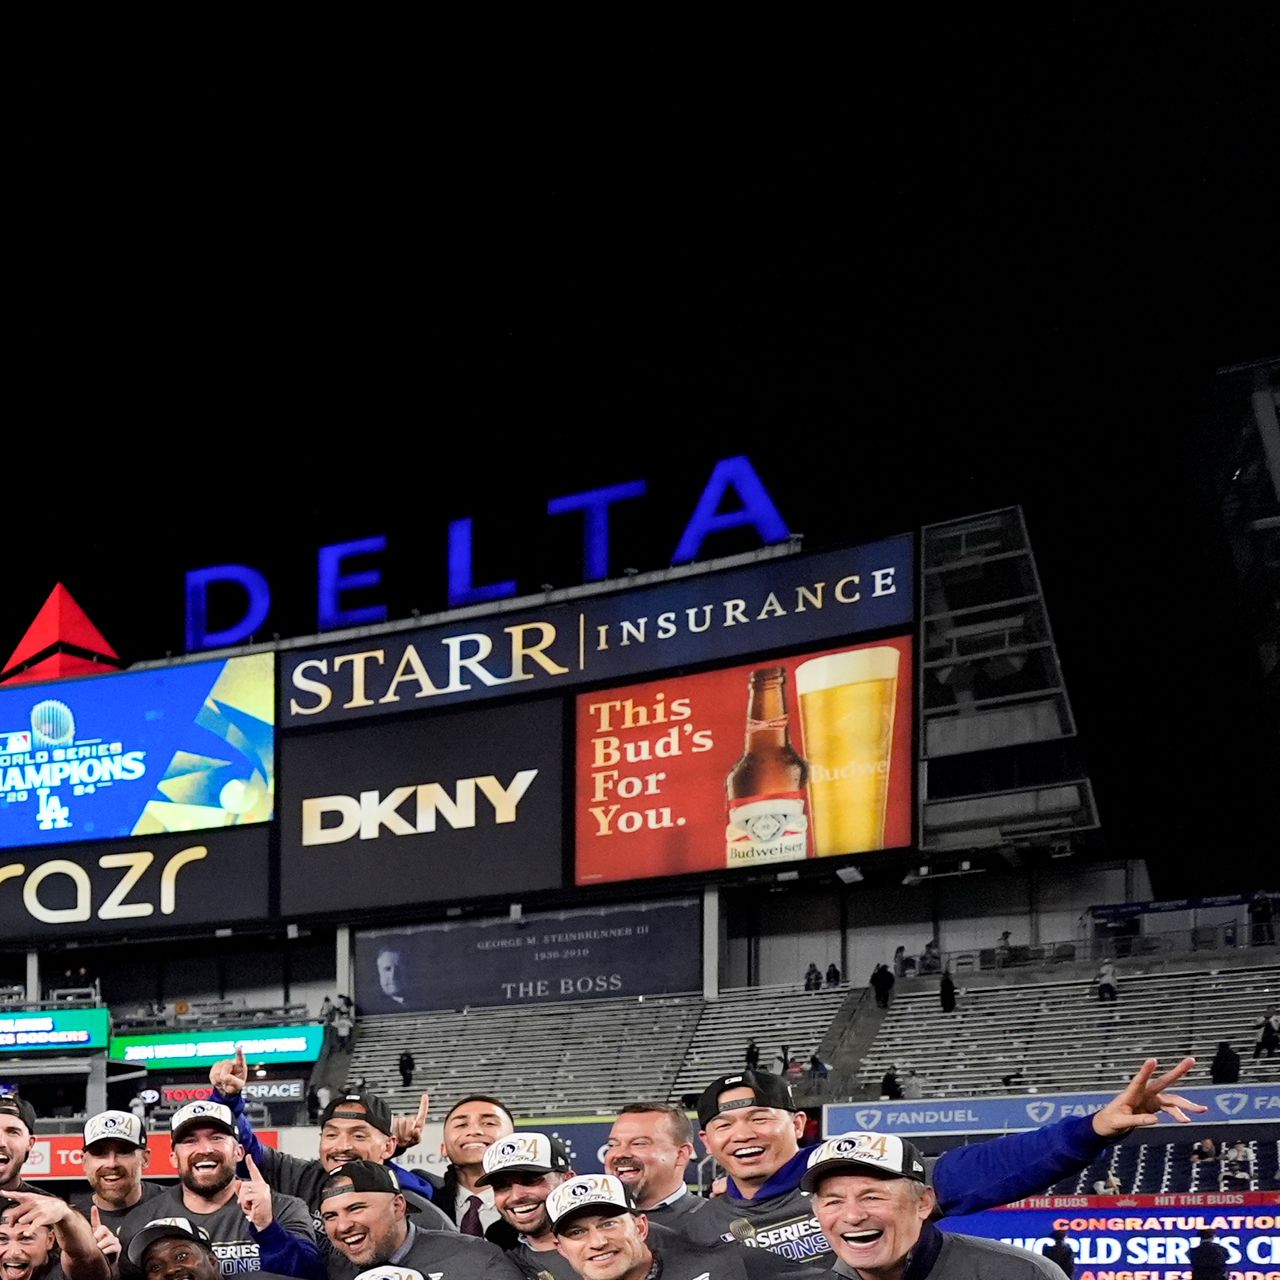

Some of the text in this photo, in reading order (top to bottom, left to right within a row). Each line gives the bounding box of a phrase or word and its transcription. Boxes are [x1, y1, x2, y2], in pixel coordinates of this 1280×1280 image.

[184, 455, 793, 652] DELTA
[288, 563, 897, 717] STARR INSURANCE
[589, 692, 692, 733] This
[52, 742, 123, 763] SERIES
[590, 723, 714, 768] Bud's
[6, 791, 28, 803] 20
[591, 771, 667, 803] For
[36, 788, 71, 831] LA
[300, 768, 539, 847] DKNY
[589, 806, 687, 837] You.
[729, 841, 804, 861] Budweiser
[477, 937, 522, 950] GEORGE
[502, 973, 623, 999] THE BOSS
[13, 1030, 89, 1046] DODGERS
[164, 1083, 301, 1101] TOYOT ERRACE
[886, 1109, 979, 1125] FANDUEL
[1028, 1197, 1051, 1208] THE
[1054, 1197, 1089, 1208] BUDS
[1154, 1193, 1245, 1206] HIT THE BUDS
[1052, 1215, 1280, 1231] CONGRATULATIO
